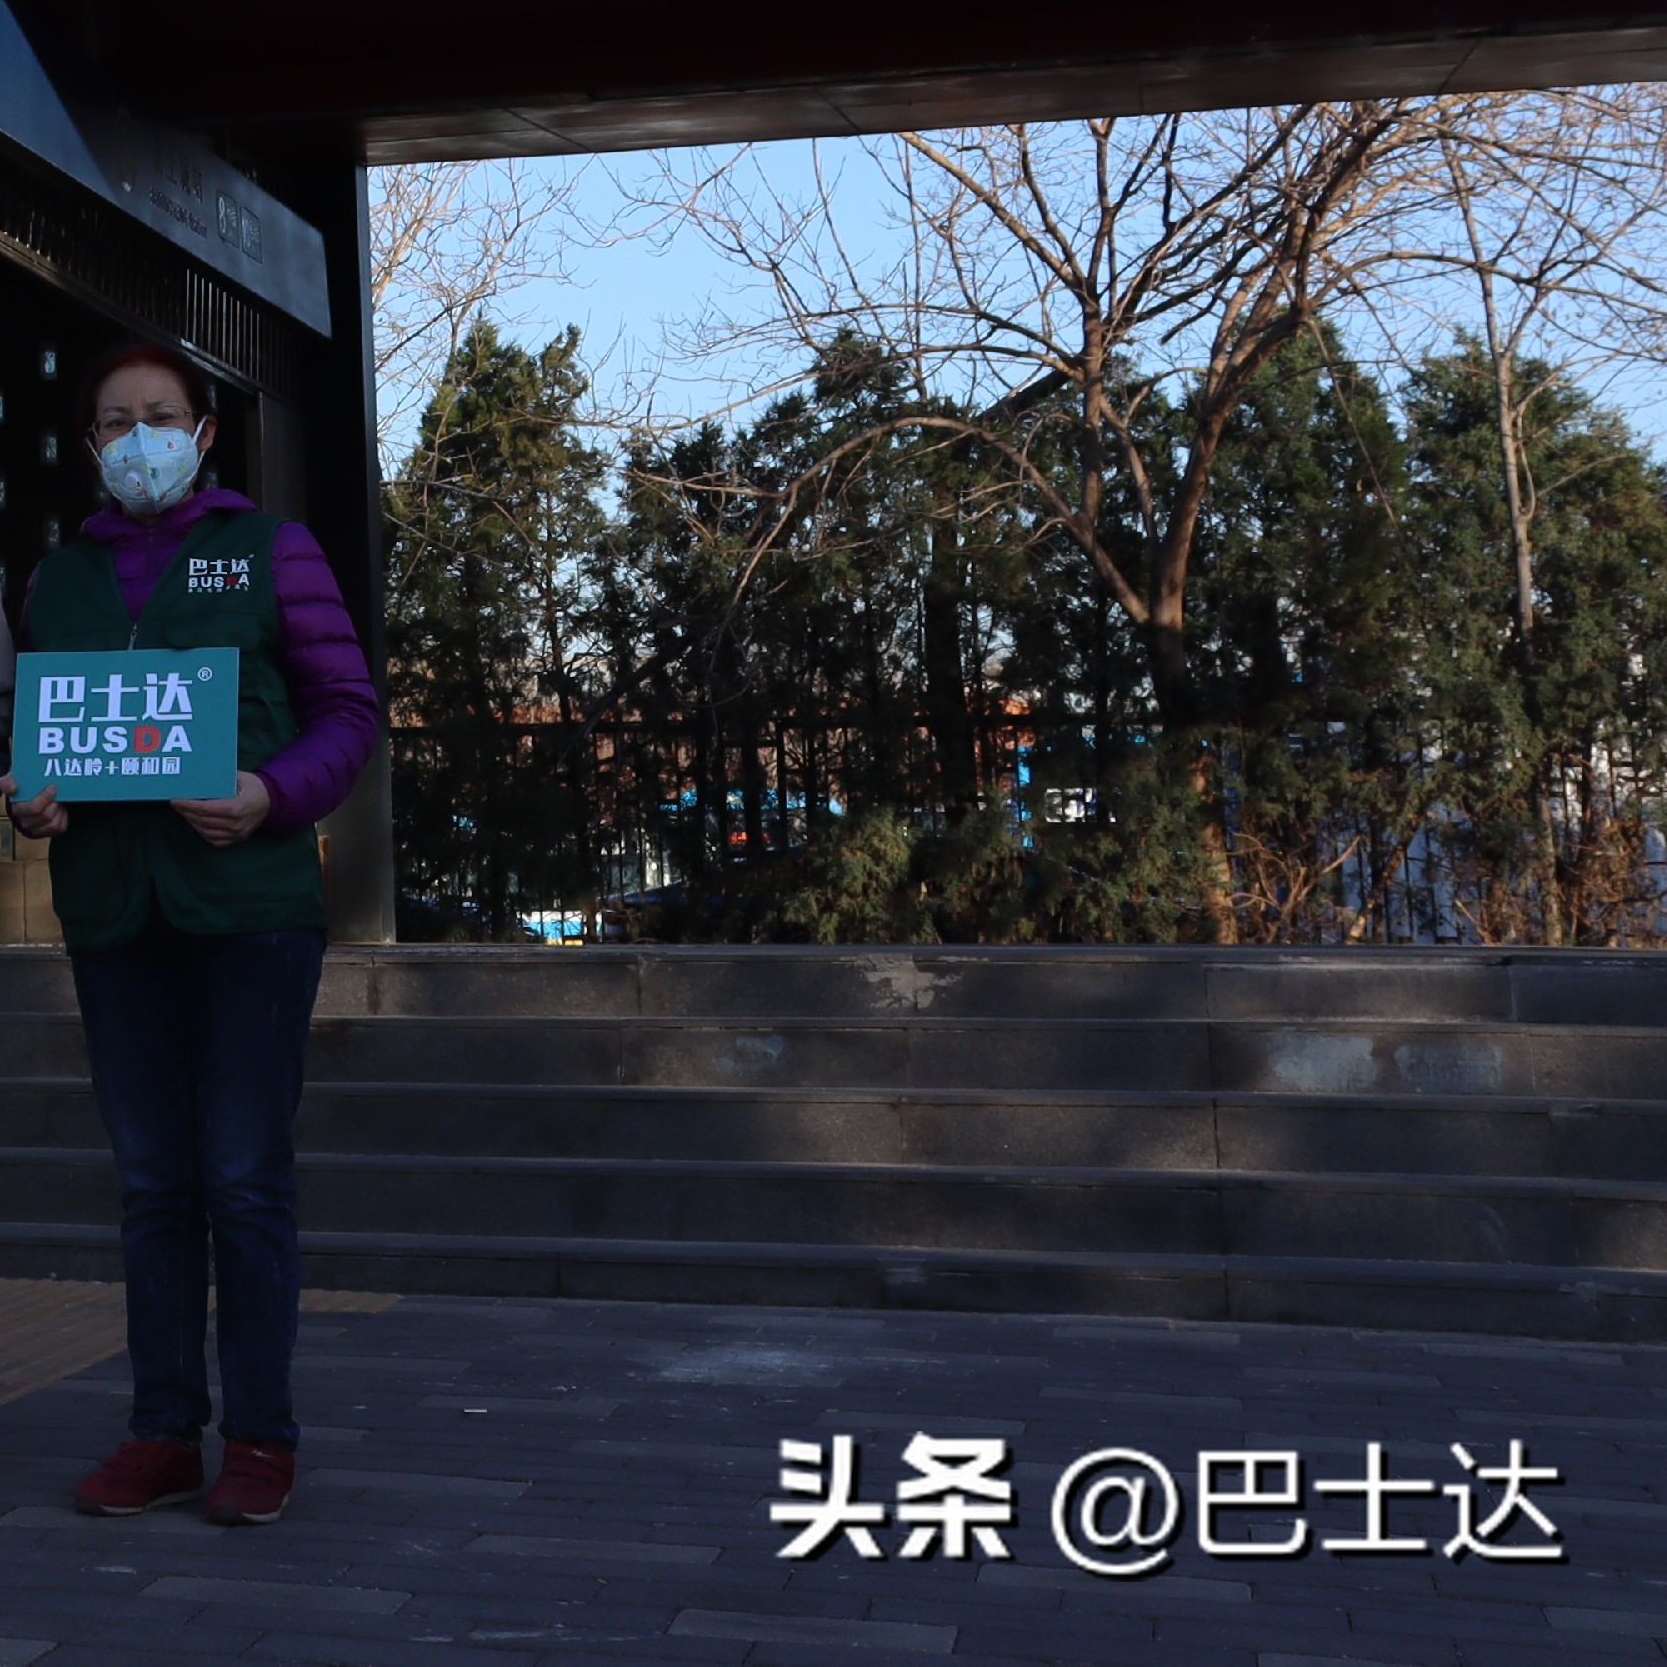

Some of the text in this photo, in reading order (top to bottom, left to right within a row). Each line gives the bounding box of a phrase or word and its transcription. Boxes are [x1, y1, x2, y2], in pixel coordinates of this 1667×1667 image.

[188, 558, 249, 576] 巴士达
[38, 672, 193, 723] 巴士达
[38, 725, 193, 754] BUSDA
